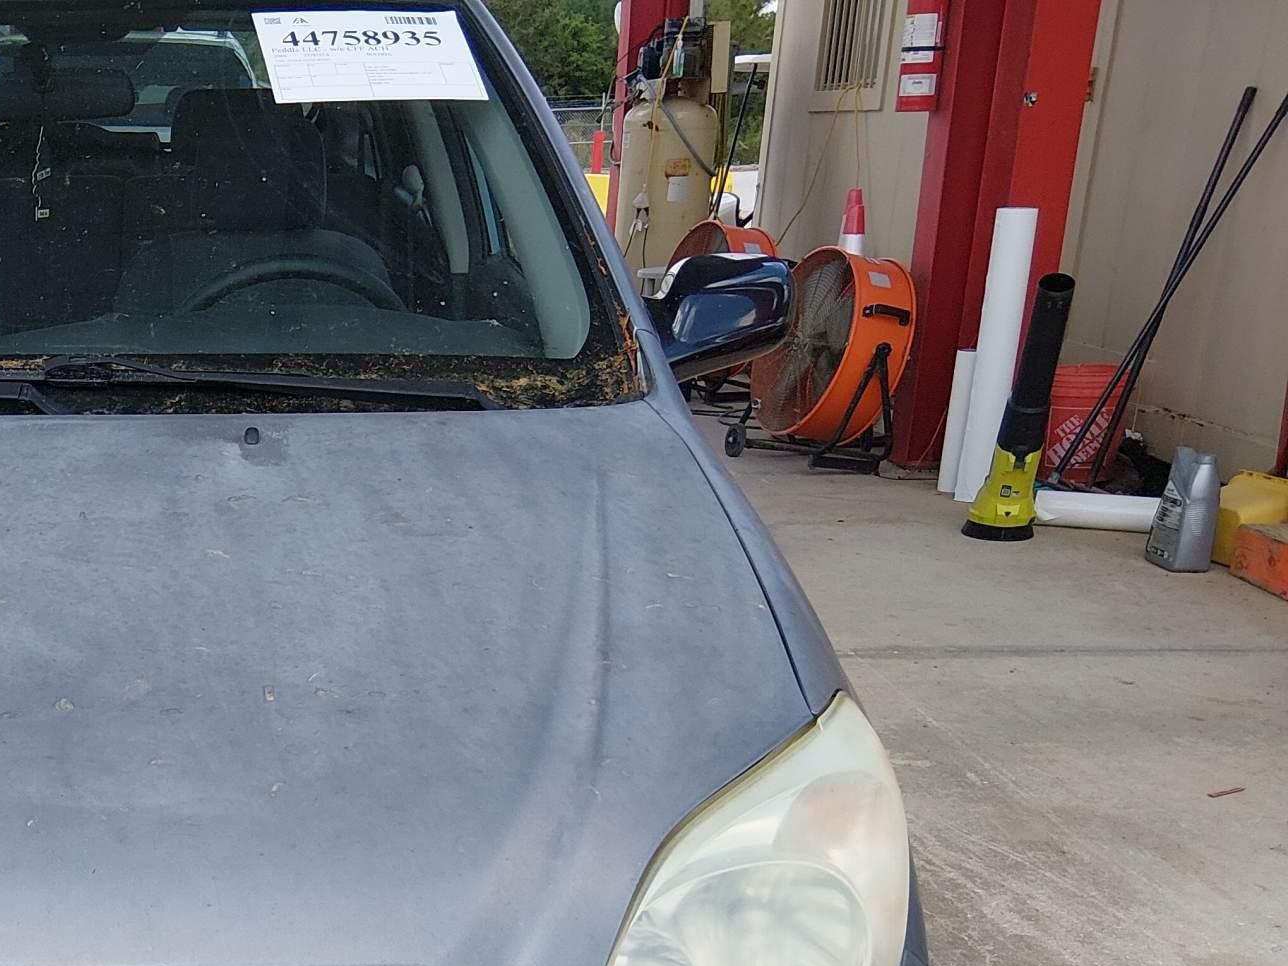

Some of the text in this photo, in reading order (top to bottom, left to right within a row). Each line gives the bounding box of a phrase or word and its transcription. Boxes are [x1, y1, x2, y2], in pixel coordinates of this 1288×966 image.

[282, 30, 442, 47] 44758935
[1054, 414, 1084, 439] THE
[1069, 431, 1106, 465] DEPO
